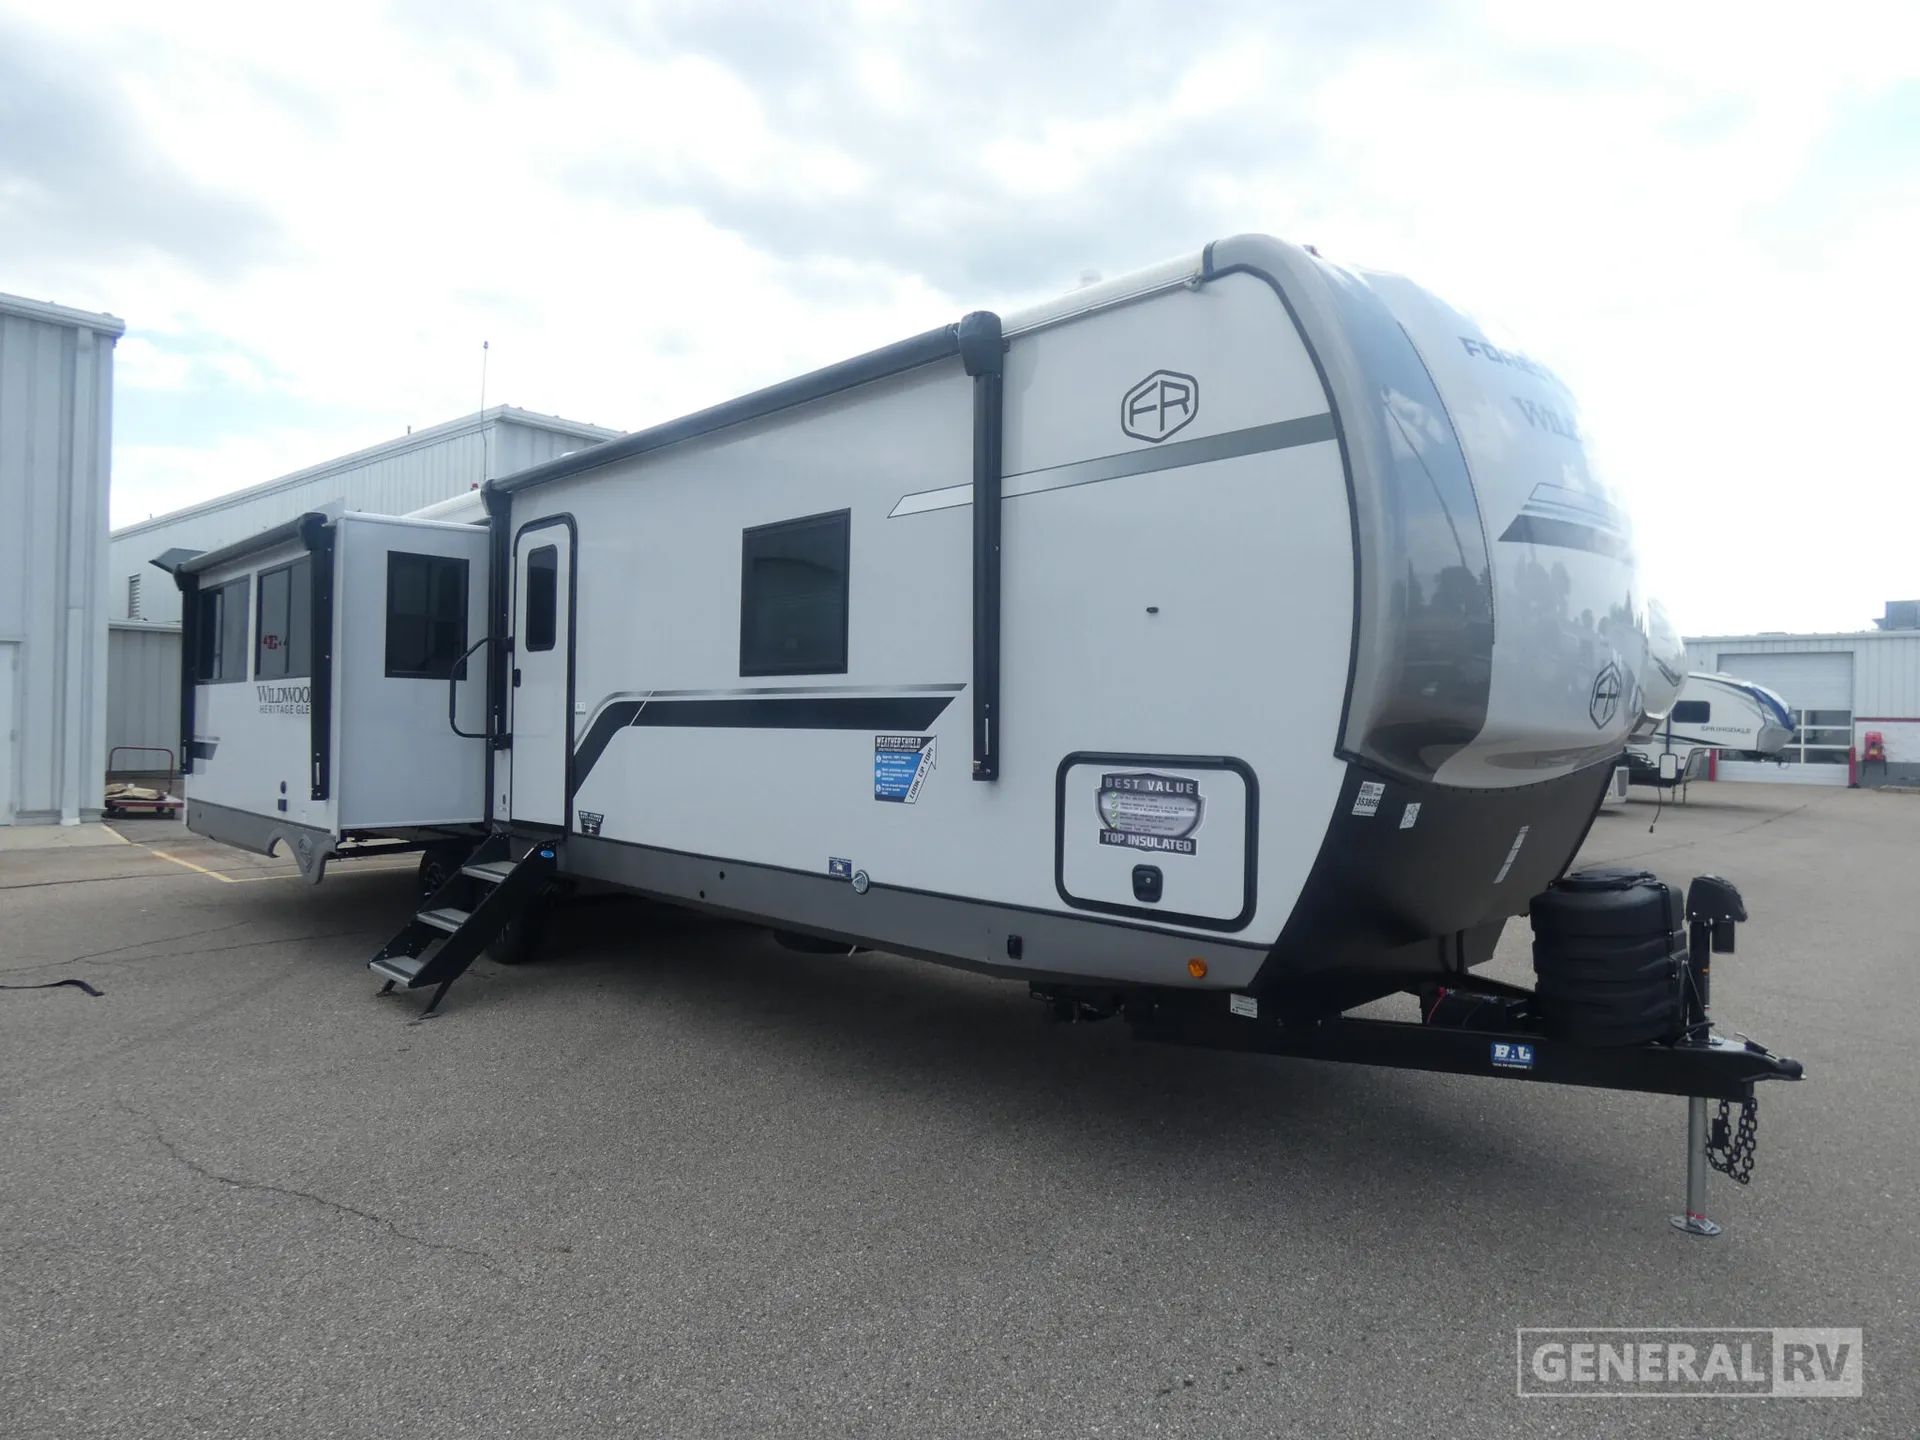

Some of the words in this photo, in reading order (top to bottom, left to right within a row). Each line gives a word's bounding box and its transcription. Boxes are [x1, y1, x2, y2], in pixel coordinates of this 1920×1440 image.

[256, 685, 311, 704] WILDWOO
[259, 703, 294, 714] HERITAGE
[295, 704, 311, 714] GLE
[1105, 777, 1140, 790] BEST
[1147, 780, 1194, 794] VALUE
[1104, 832, 1125, 844] TOP
[1127, 834, 1192, 852] INSULATED
